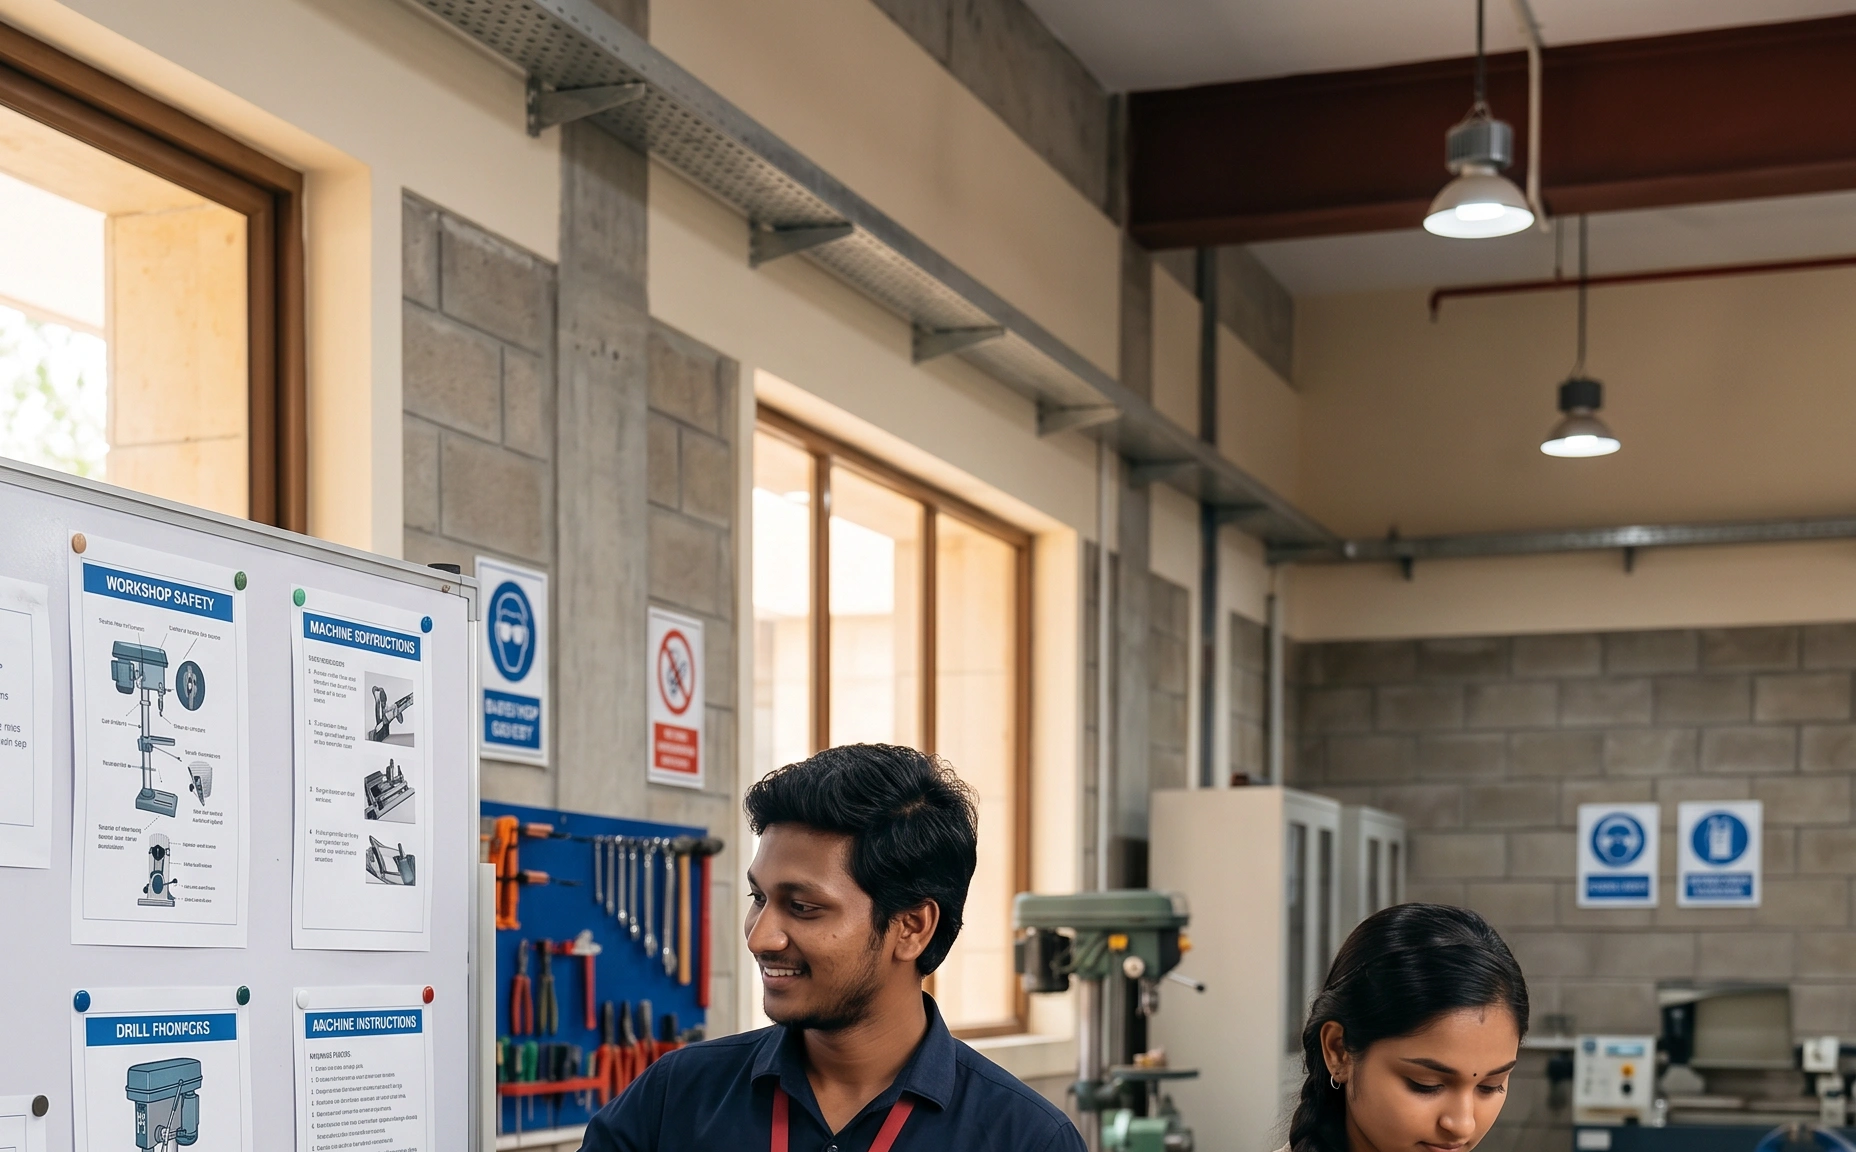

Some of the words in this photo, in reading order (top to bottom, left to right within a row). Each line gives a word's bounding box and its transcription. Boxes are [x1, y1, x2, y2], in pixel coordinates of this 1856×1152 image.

[106, 575, 172, 602] WORKSHOP
[174, 591, 215, 611] SAFETY
[310, 620, 353, 641] MACHINE
[116, 1023, 150, 1038] DRILL
[356, 1015, 417, 1030] INSTRUCTIONS
